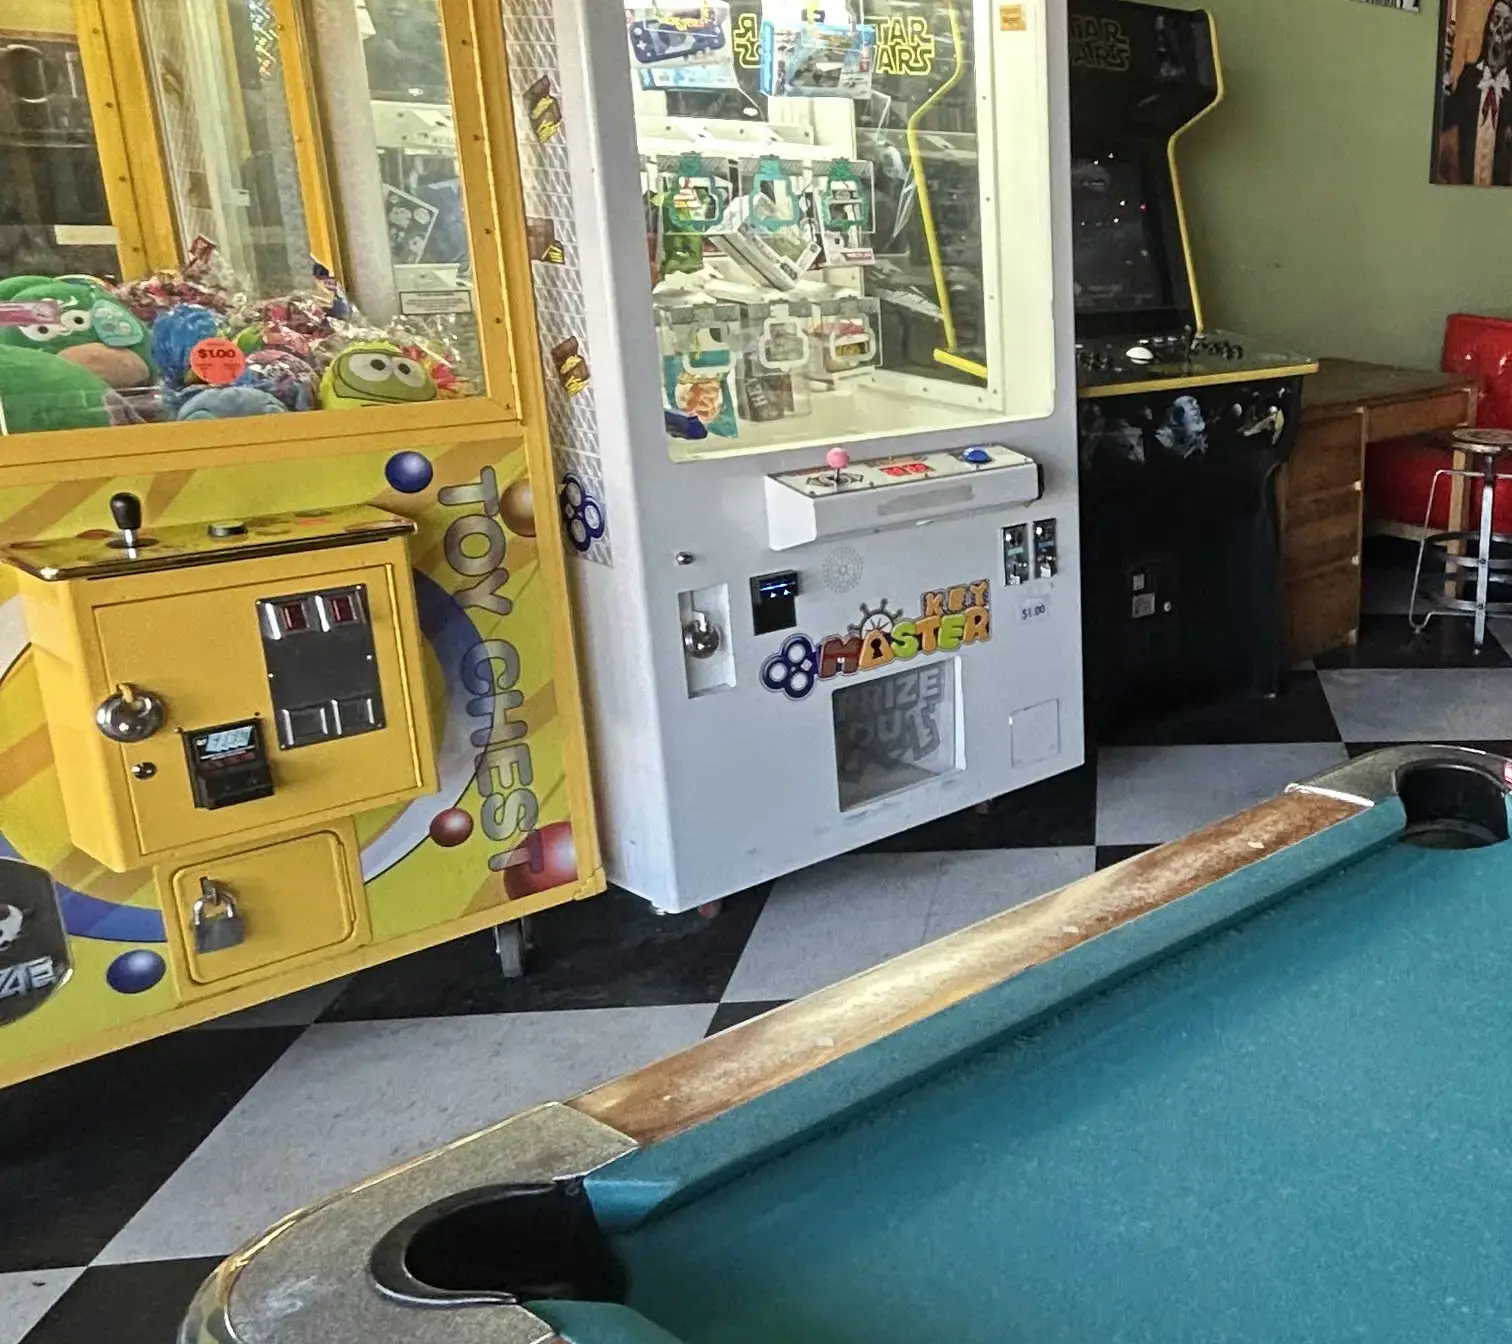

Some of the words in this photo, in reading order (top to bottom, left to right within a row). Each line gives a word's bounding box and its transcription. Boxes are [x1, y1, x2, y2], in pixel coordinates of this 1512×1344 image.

[872, 16, 935, 47] TAR
[1070, 13, 1130, 46] TAR
[872, 44, 936, 75] ARS
[1069, 38, 1131, 72] ARS
[438, 465, 512, 617] TOY
[924, 580, 990, 617] KEY
[1021, 603, 1046, 621] $1.00
[817, 606, 991, 679] MASTER
[460, 637, 546, 874] CHEST
